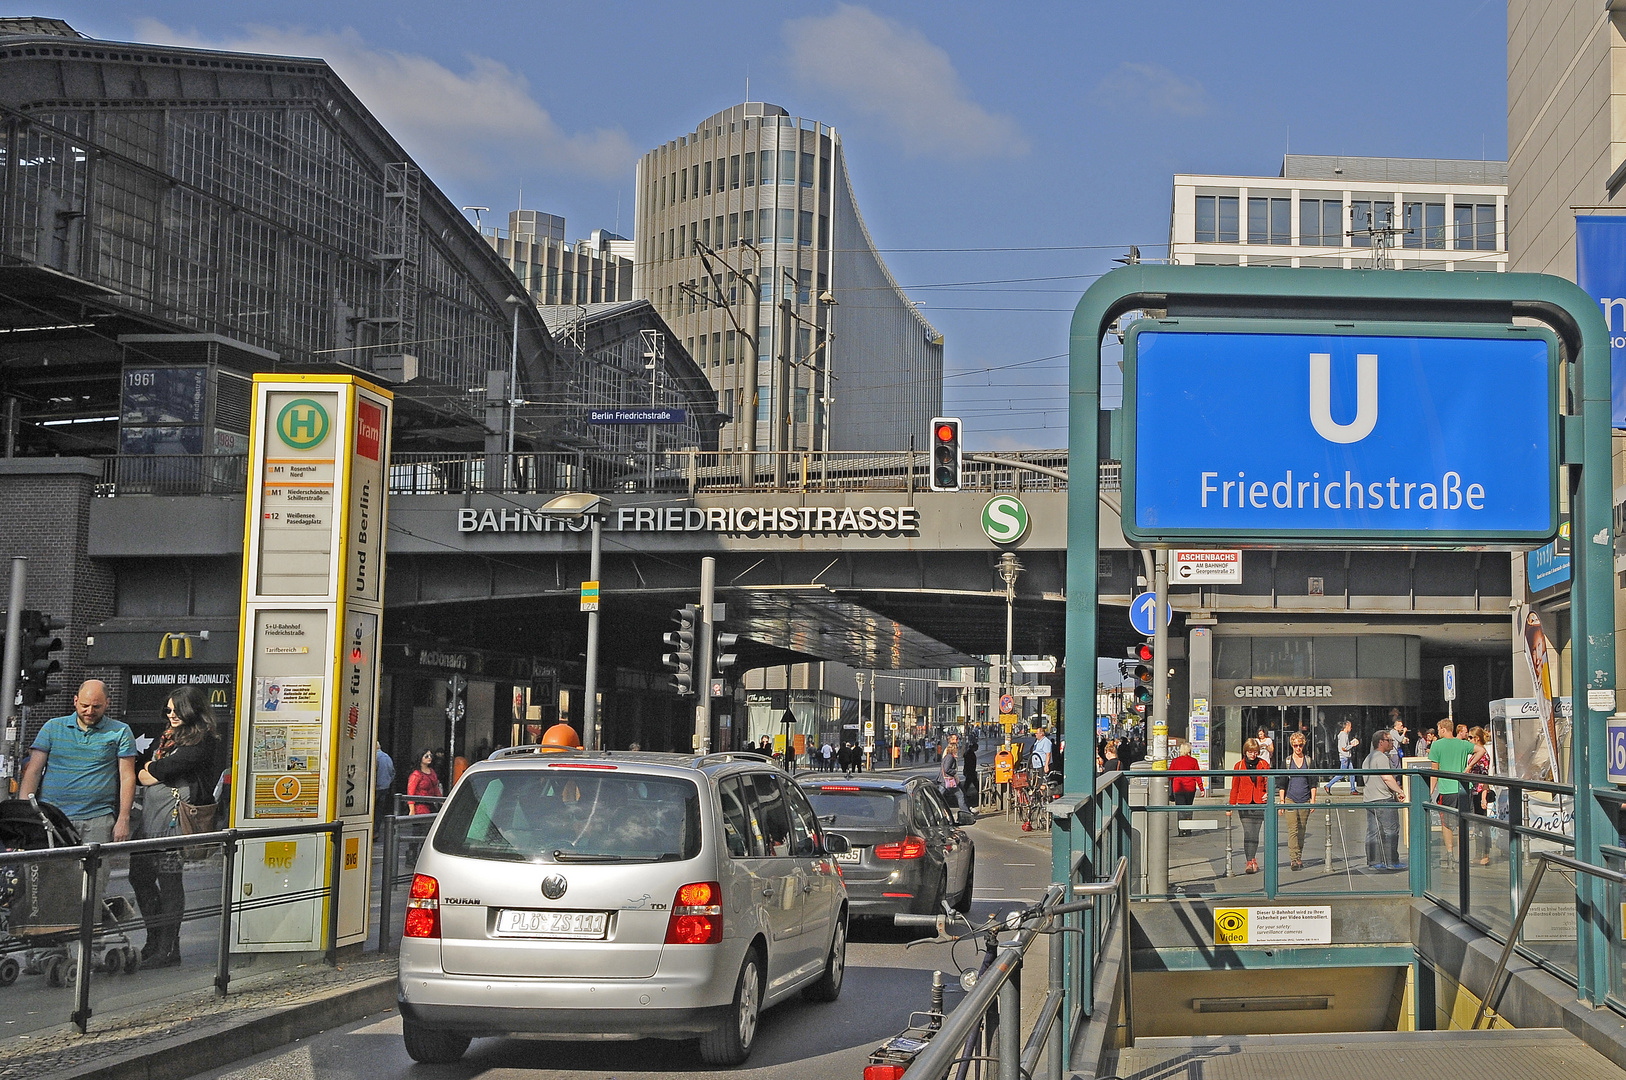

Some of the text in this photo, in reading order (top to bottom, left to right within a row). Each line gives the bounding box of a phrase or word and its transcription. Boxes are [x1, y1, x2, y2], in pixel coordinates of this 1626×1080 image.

[128, 373, 155, 386] 1961
[1309, 353, 1378, 444] U
[290, 410, 316, 438] H
[591, 411, 671, 420] Berlin Friedrichstraße
[358, 418, 379, 442] Tram
[1201, 470, 1486, 511] Friedrichstraße
[271, 512, 279, 520] 12
[457, 506, 916, 532] BAHNHO FRIEDRICHSTRASSE
[988, 498, 1020, 540] S
[356, 479, 371, 592] Und Berlin.
[1180, 553, 1236, 561] ASCHENBACHS
[352, 622, 363, 660] Sie.
[131, 674, 176, 685] WILLKOMMEN
[177, 674, 188, 685] BEI
[350, 664, 361, 696] für
[1233, 685, 1333, 698] GERRY WEBER
[345, 764, 356, 808] BVG
[268, 857, 293, 869] BVG
[345, 852, 358, 866] BVG
[444, 897, 481, 905] TOURAN
[510, 912, 604, 933] PLÖ ZS 111
[1219, 933, 1244, 942] Video
